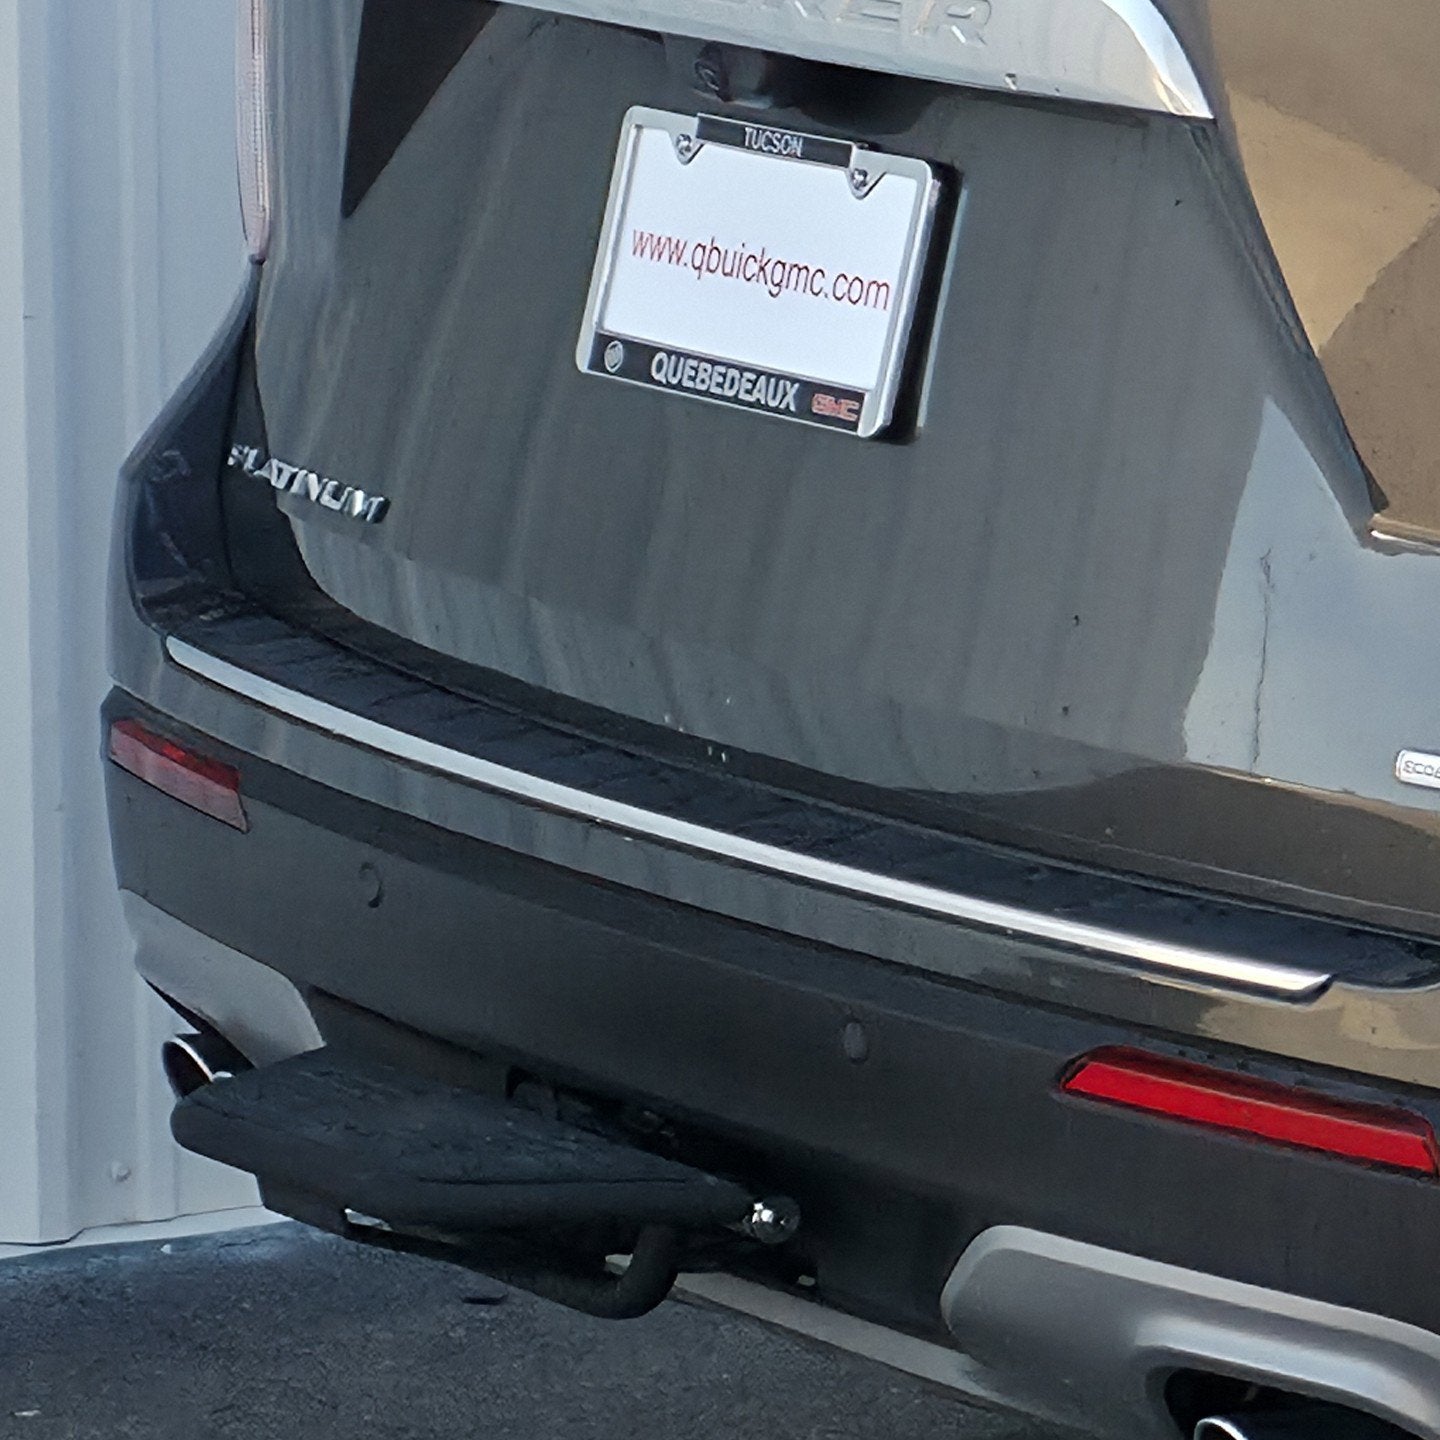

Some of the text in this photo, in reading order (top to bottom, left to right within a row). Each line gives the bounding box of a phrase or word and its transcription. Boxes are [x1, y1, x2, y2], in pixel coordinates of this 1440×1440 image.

[744, 126, 803, 158] TUCSON
[631, 228, 891, 311] www.qbuickgmc.com
[650, 351, 860, 422] QUEBEDEAUX GMC
[227, 443, 391, 523] PLATINUM
